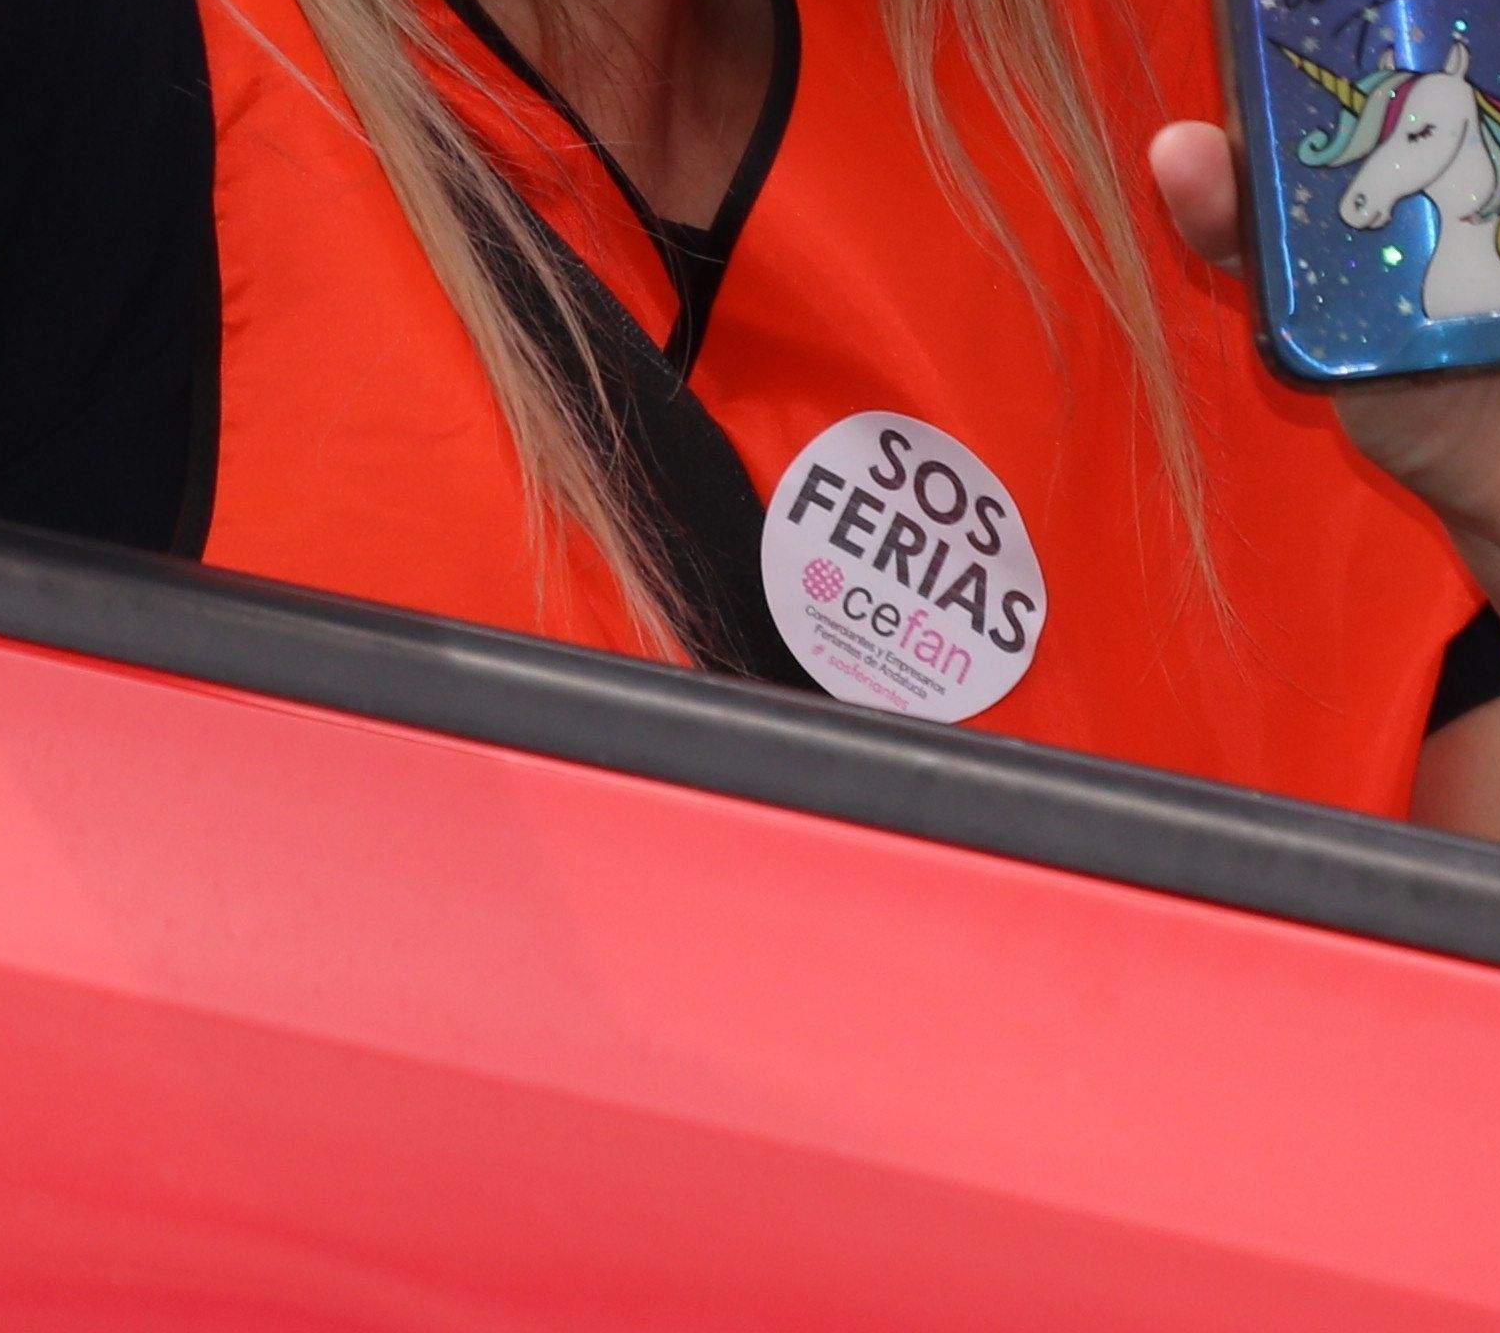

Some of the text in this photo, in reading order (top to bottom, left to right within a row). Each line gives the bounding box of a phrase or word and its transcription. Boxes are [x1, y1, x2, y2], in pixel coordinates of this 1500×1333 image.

[869, 429, 1006, 556] SOS
[787, 463, 1036, 653] FERIAS
[843, 587, 972, 684] cefan
